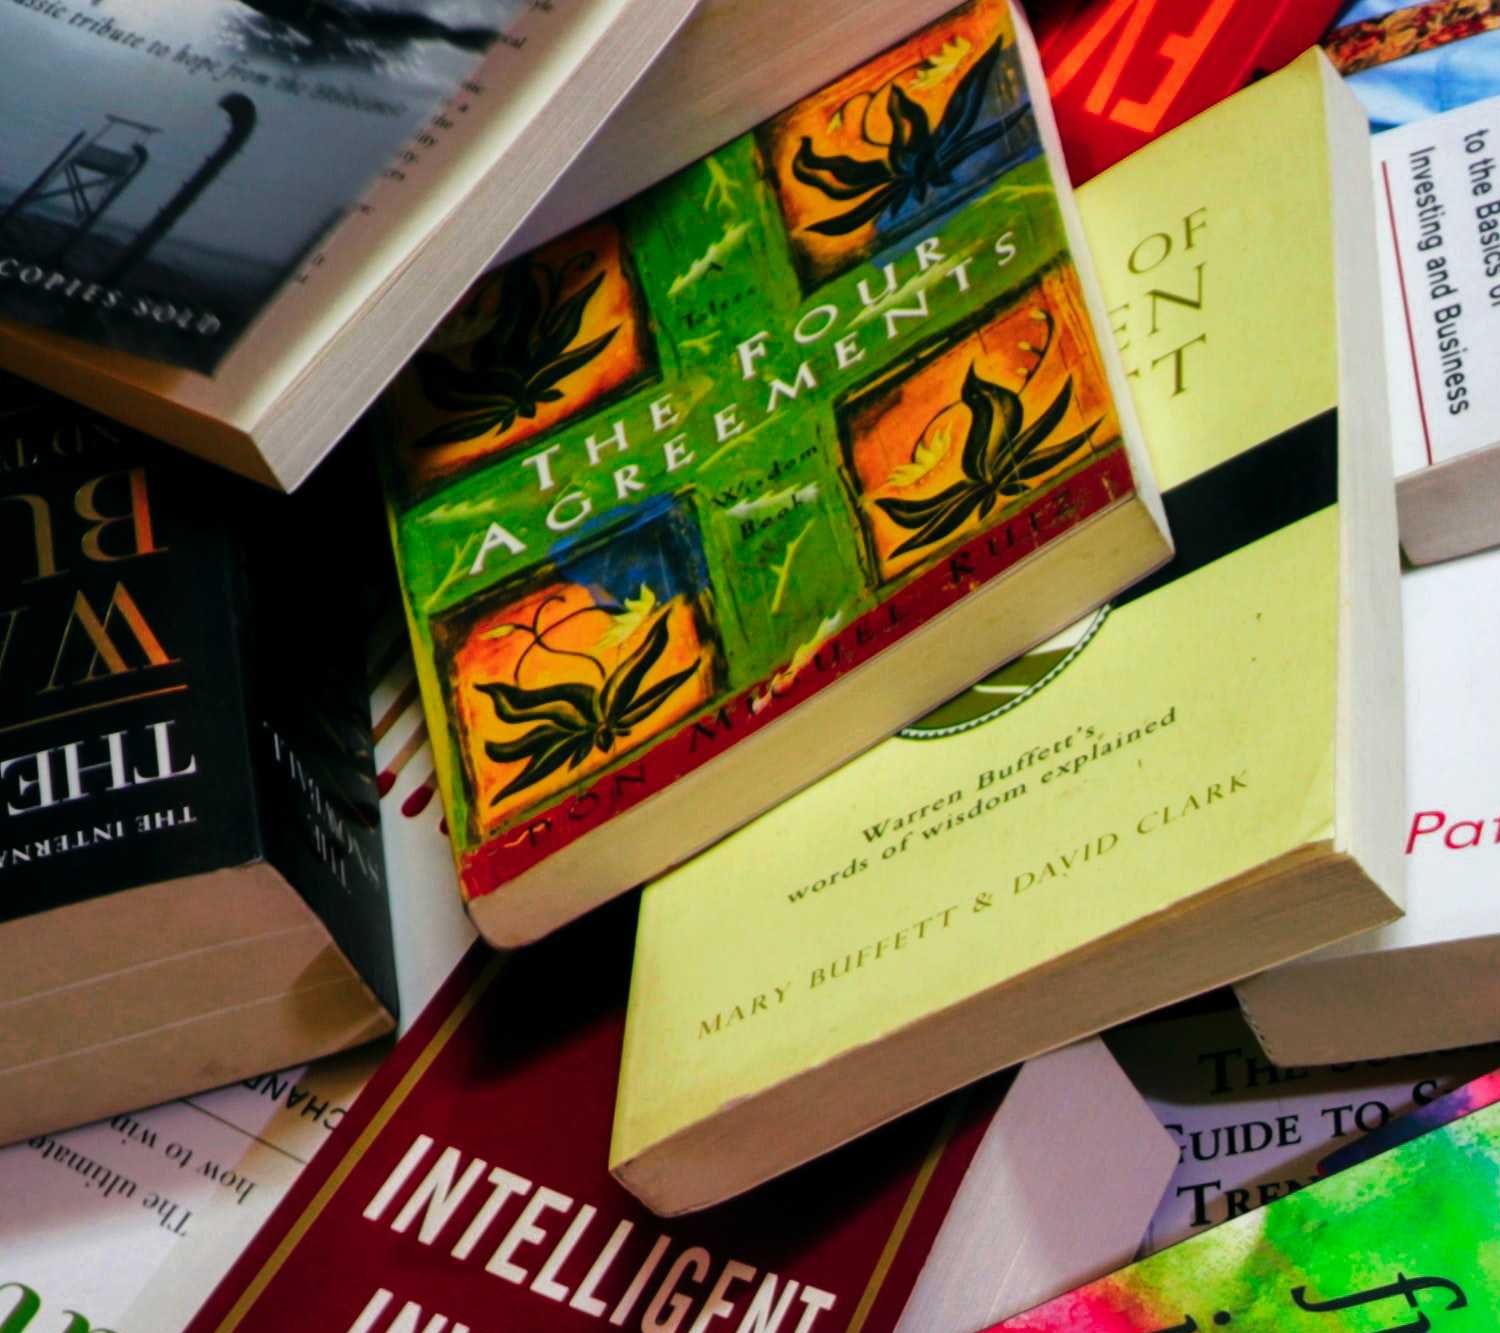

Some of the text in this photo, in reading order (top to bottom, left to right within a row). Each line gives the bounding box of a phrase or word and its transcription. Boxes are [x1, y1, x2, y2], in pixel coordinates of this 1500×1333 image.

[132, 282, 221, 337] SOLD
[521, 236, 955, 493] THE FOUR
[1410, 146, 1469, 415] Investing and Business
[467, 232, 1021, 577] AGREEMENTS
[787, 705, 1176, 903] words of wisdom explained
[862, 789, 963, 843] Warren
